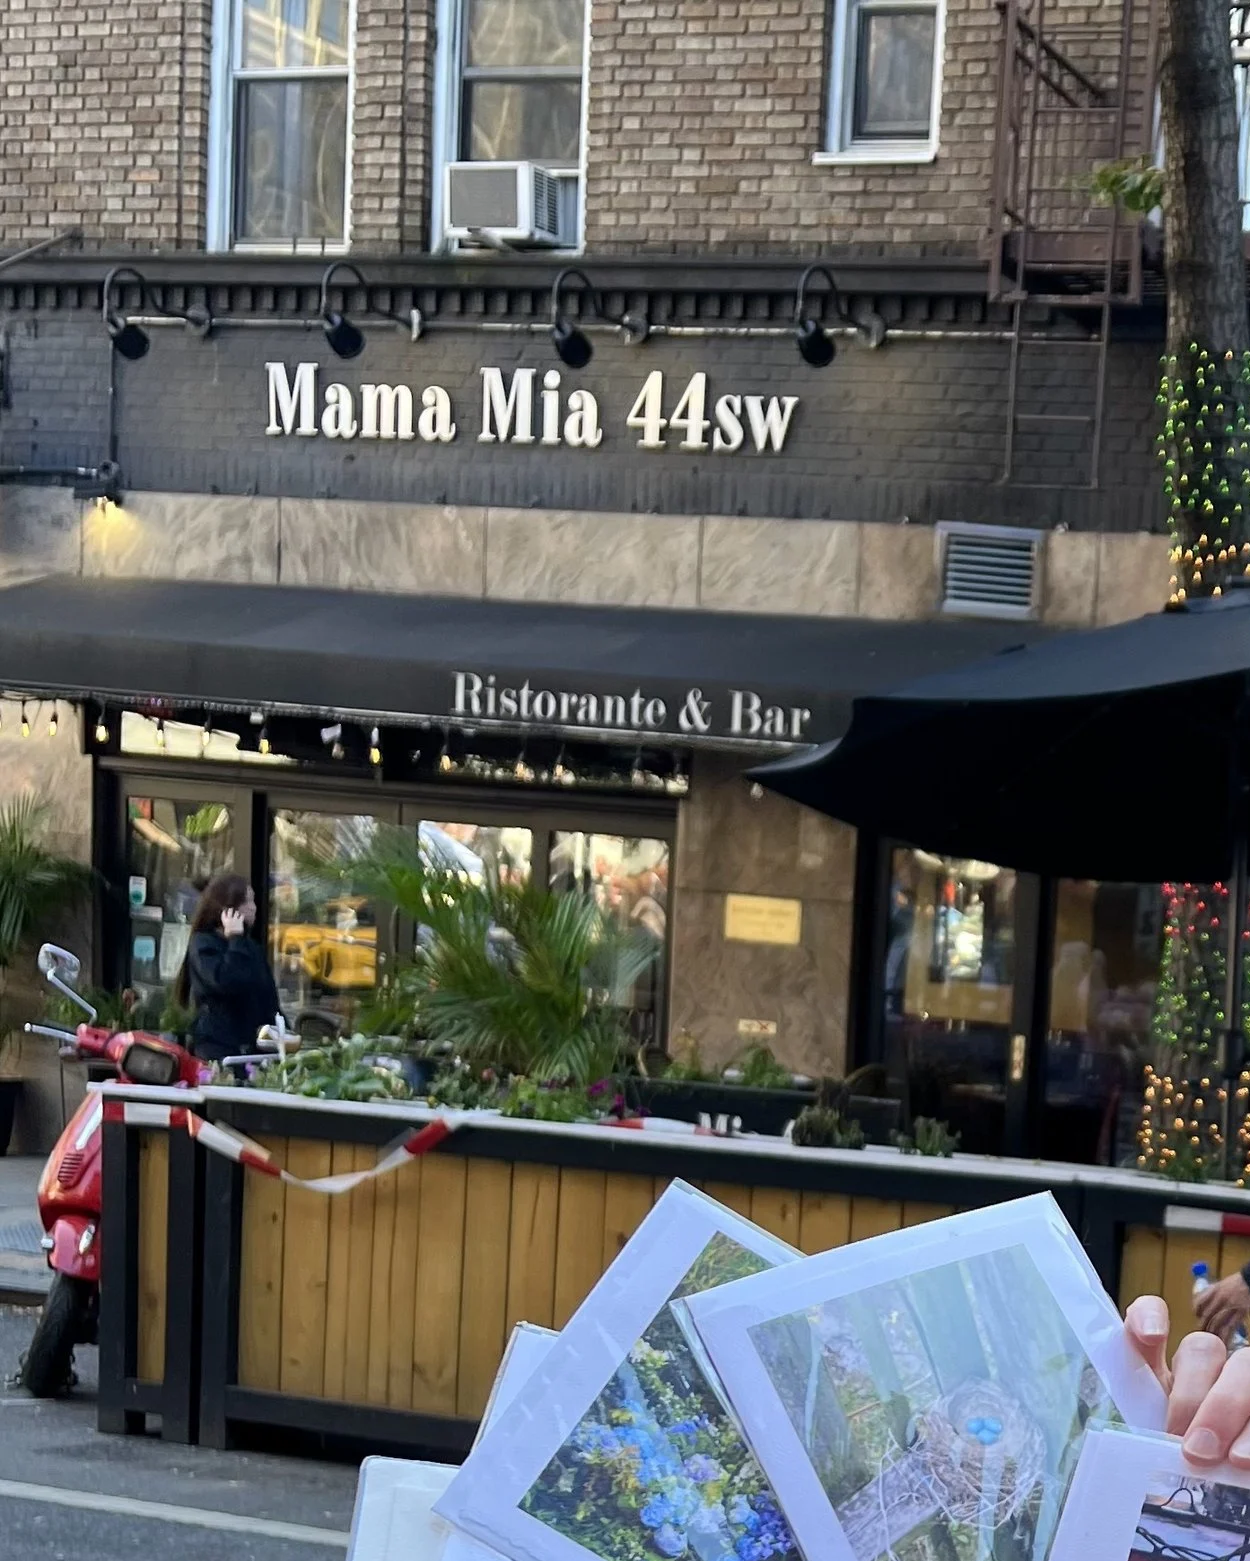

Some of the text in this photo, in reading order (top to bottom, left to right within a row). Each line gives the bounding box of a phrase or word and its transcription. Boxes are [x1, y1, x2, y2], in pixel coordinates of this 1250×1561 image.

[264, 361, 800, 454] Mama Mia 44sw
[450, 670, 812, 738] Ristorante & Bar
